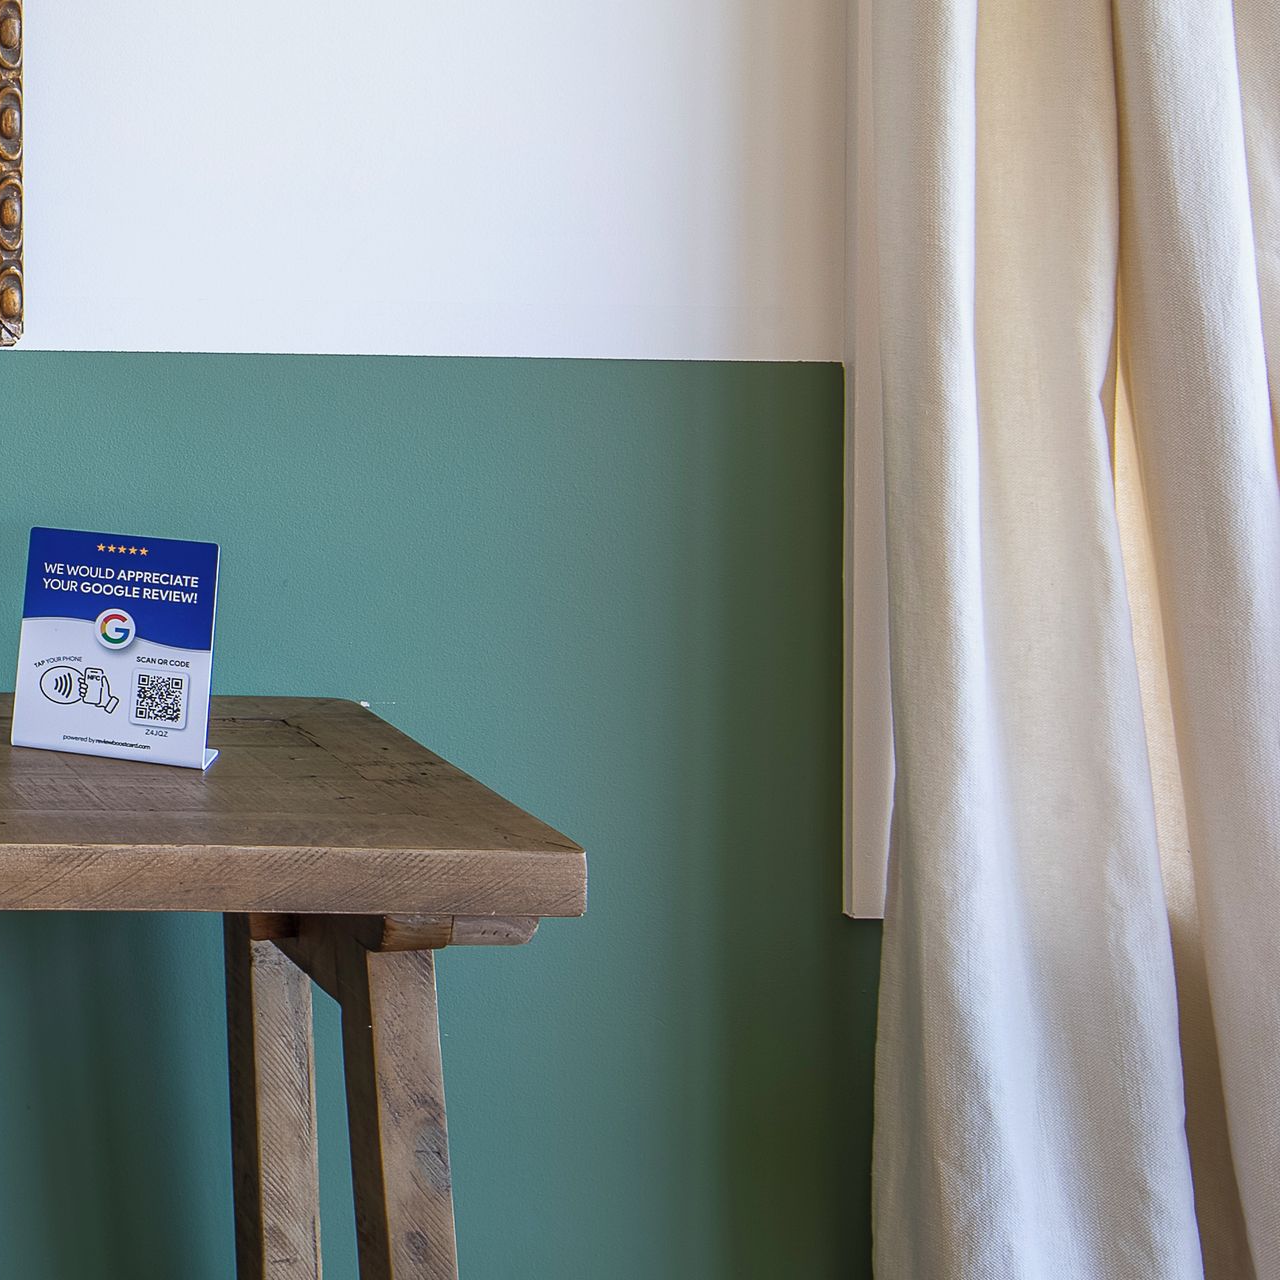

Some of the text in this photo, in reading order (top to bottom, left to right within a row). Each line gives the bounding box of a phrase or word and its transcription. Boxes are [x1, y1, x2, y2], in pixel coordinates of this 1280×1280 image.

[44, 562, 199, 587] WE WOULD APPRECIATE
[42, 577, 198, 604] YOUR GOOGLE REVIEW!
[34, 660, 45, 668] TAP
[45, 656, 62, 664] YOUR
[136, 656, 191, 668] SCAN QR CODE
[87, 674, 101, 682] NFC
[62, 734, 88, 743] powered
